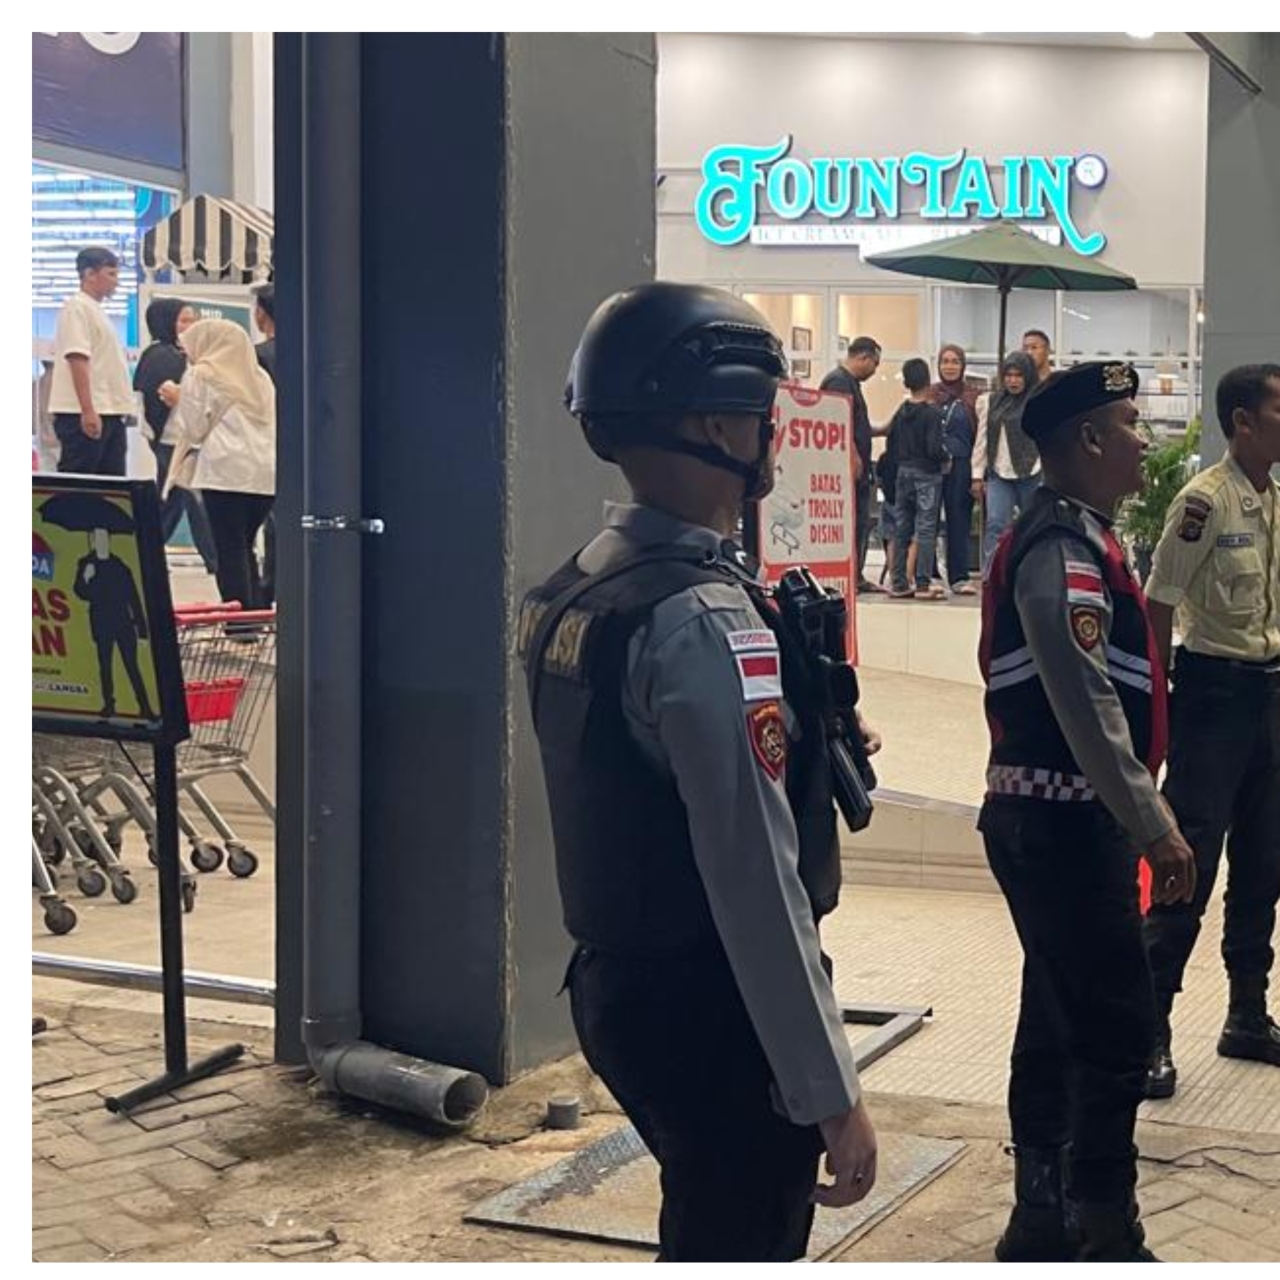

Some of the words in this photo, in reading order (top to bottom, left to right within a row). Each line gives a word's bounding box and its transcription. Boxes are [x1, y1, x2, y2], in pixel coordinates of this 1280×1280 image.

[694, 134, 1106, 254] FOUNTAIN
[789, 418, 846, 451] STOP!
[810, 474, 841, 494] BATAS
[809, 499, 844, 518] TROLLY
[810, 524, 844, 544] DISINI
